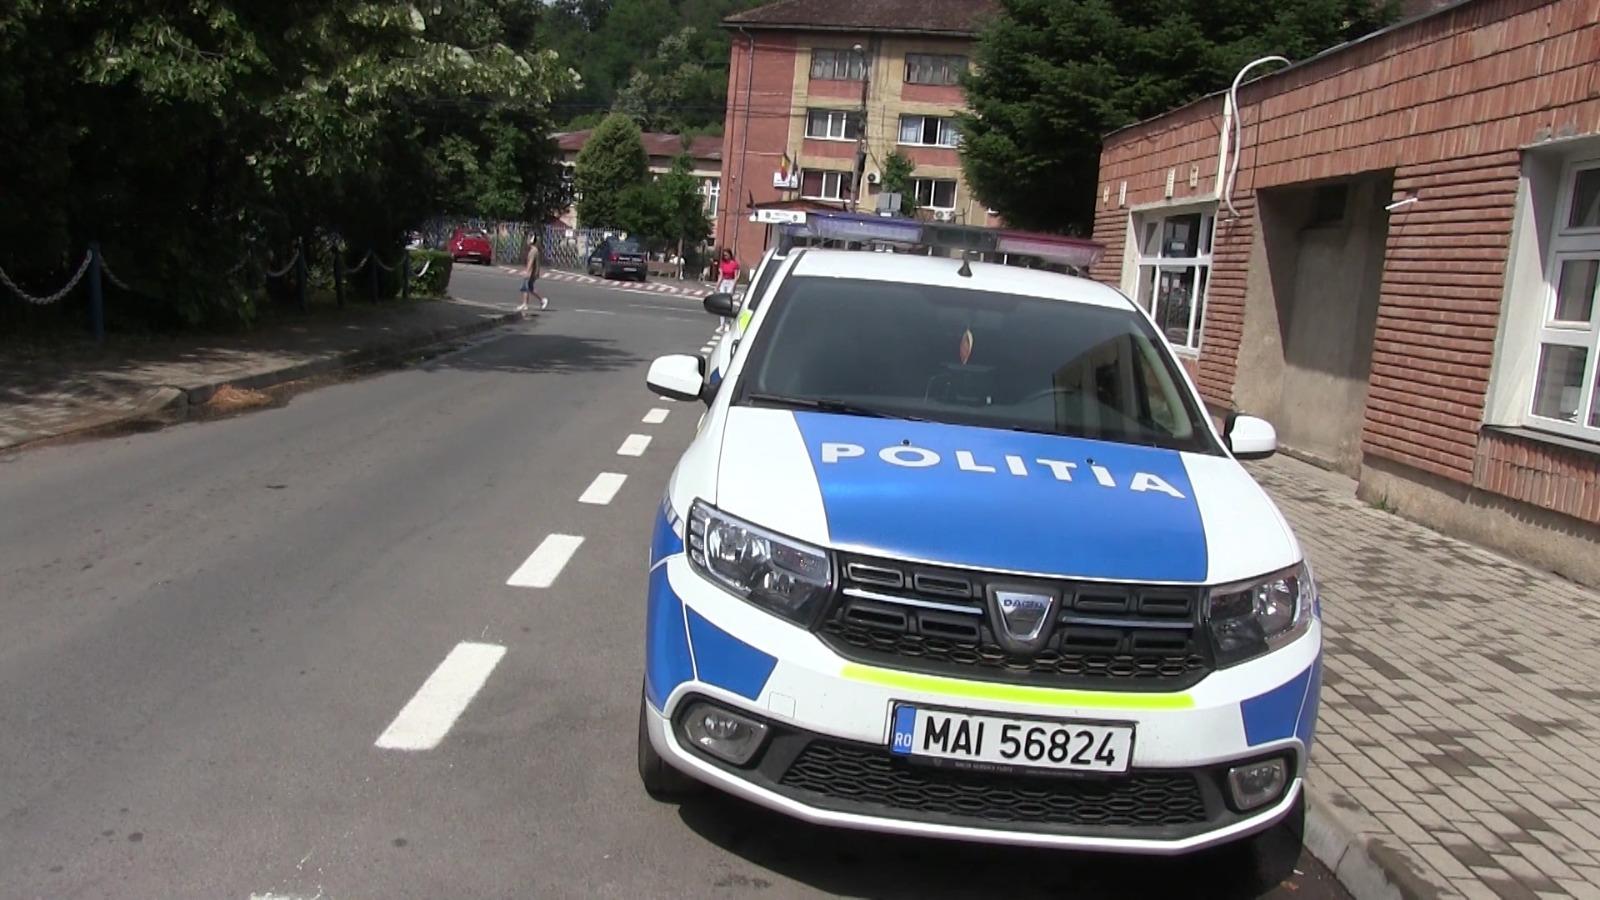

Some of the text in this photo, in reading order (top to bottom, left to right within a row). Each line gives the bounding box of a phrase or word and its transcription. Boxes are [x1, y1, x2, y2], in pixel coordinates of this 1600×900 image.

[821, 442, 1186, 499] POLITIA
[894, 732, 912, 747] RO
[923, 715, 1116, 767] MAI 56824
